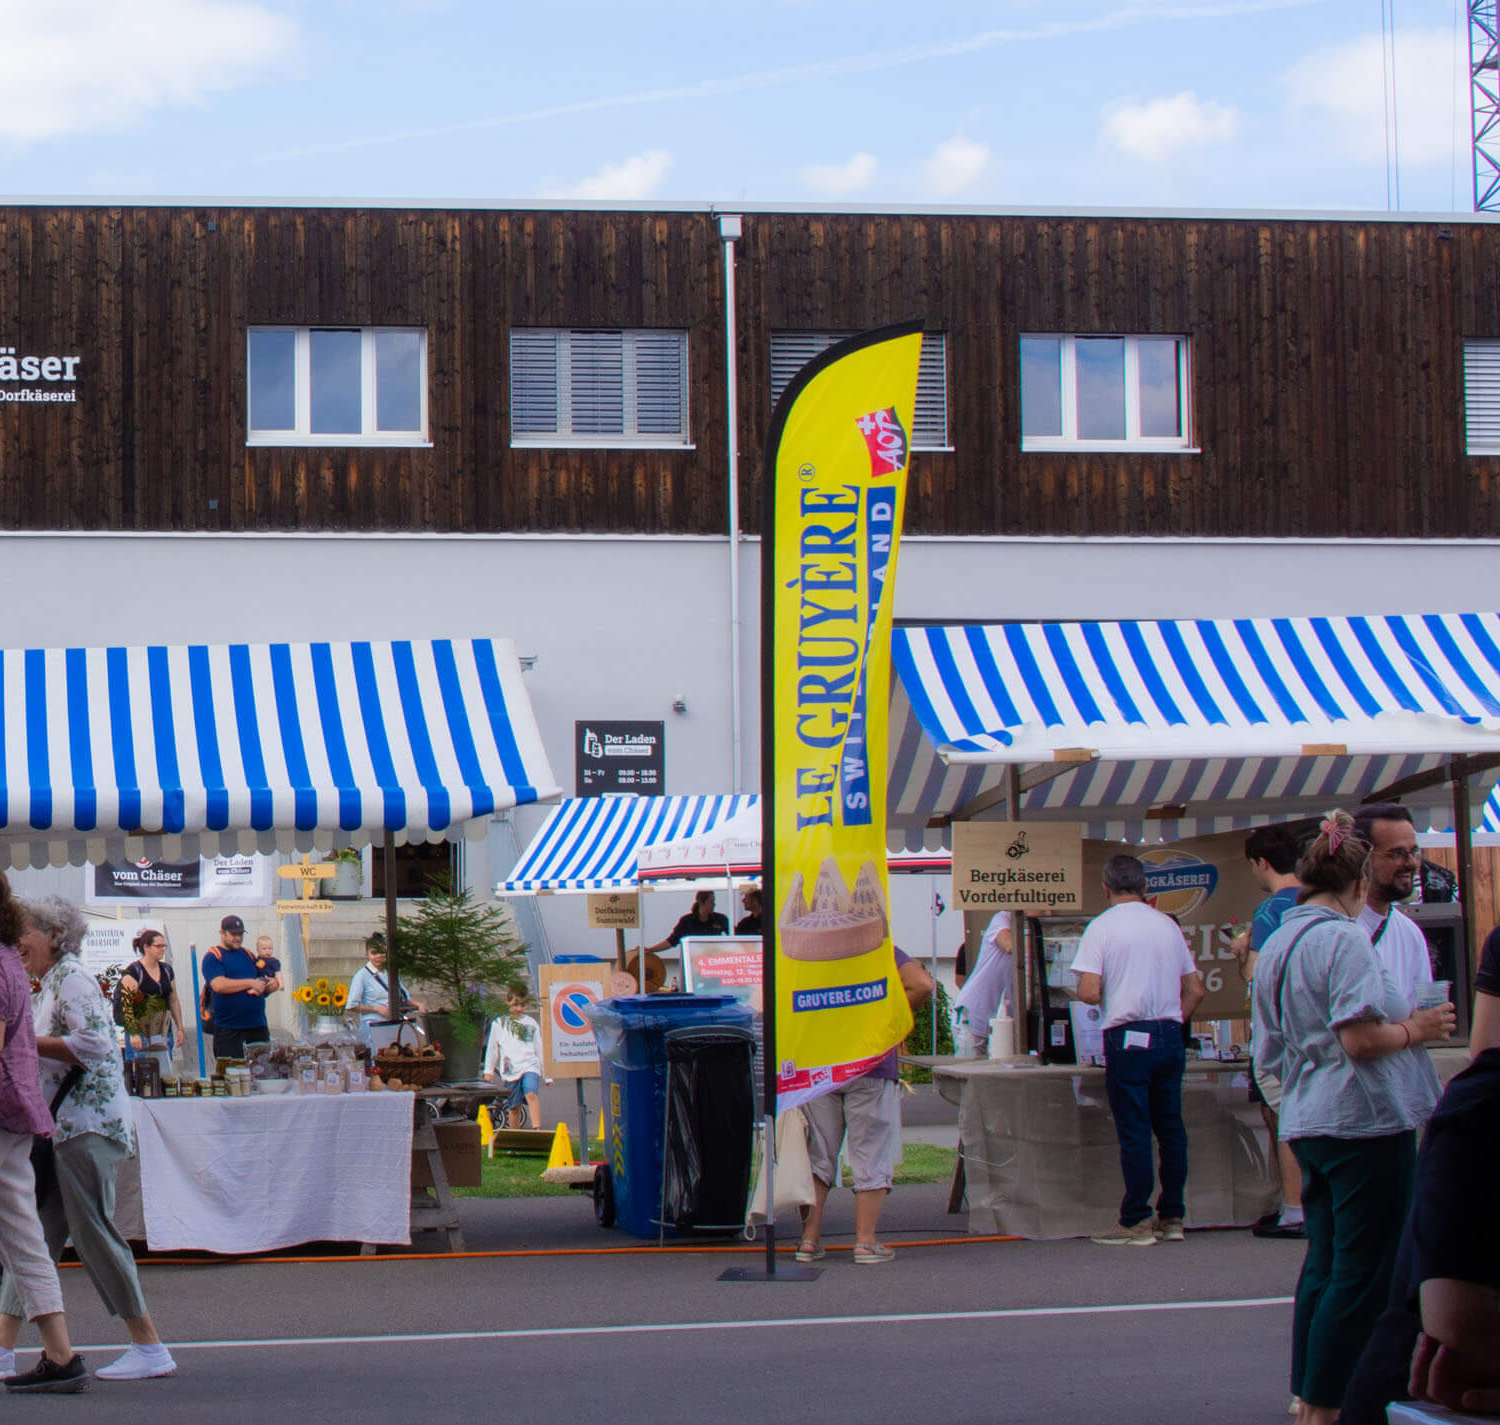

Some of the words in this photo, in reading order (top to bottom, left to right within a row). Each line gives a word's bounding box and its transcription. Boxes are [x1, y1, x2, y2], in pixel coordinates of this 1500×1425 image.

[604, 734, 623, 744] Der
[624, 733, 657, 744] Laden
[796, 763, 839, 832] LE
[113, 871, 139, 881] vom
[140, 869, 183, 881] Chäser
[300, 867, 316, 877] WC
[970, 868, 1066, 886] Bergkäserei
[1145, 873, 1211, 888] RGKÄSEREI
[959, 888, 1076, 906] Vorderfultigen
[708, 955, 762, 966] EMMENTALE
[797, 983, 884, 1009] GRUYERE.COM
